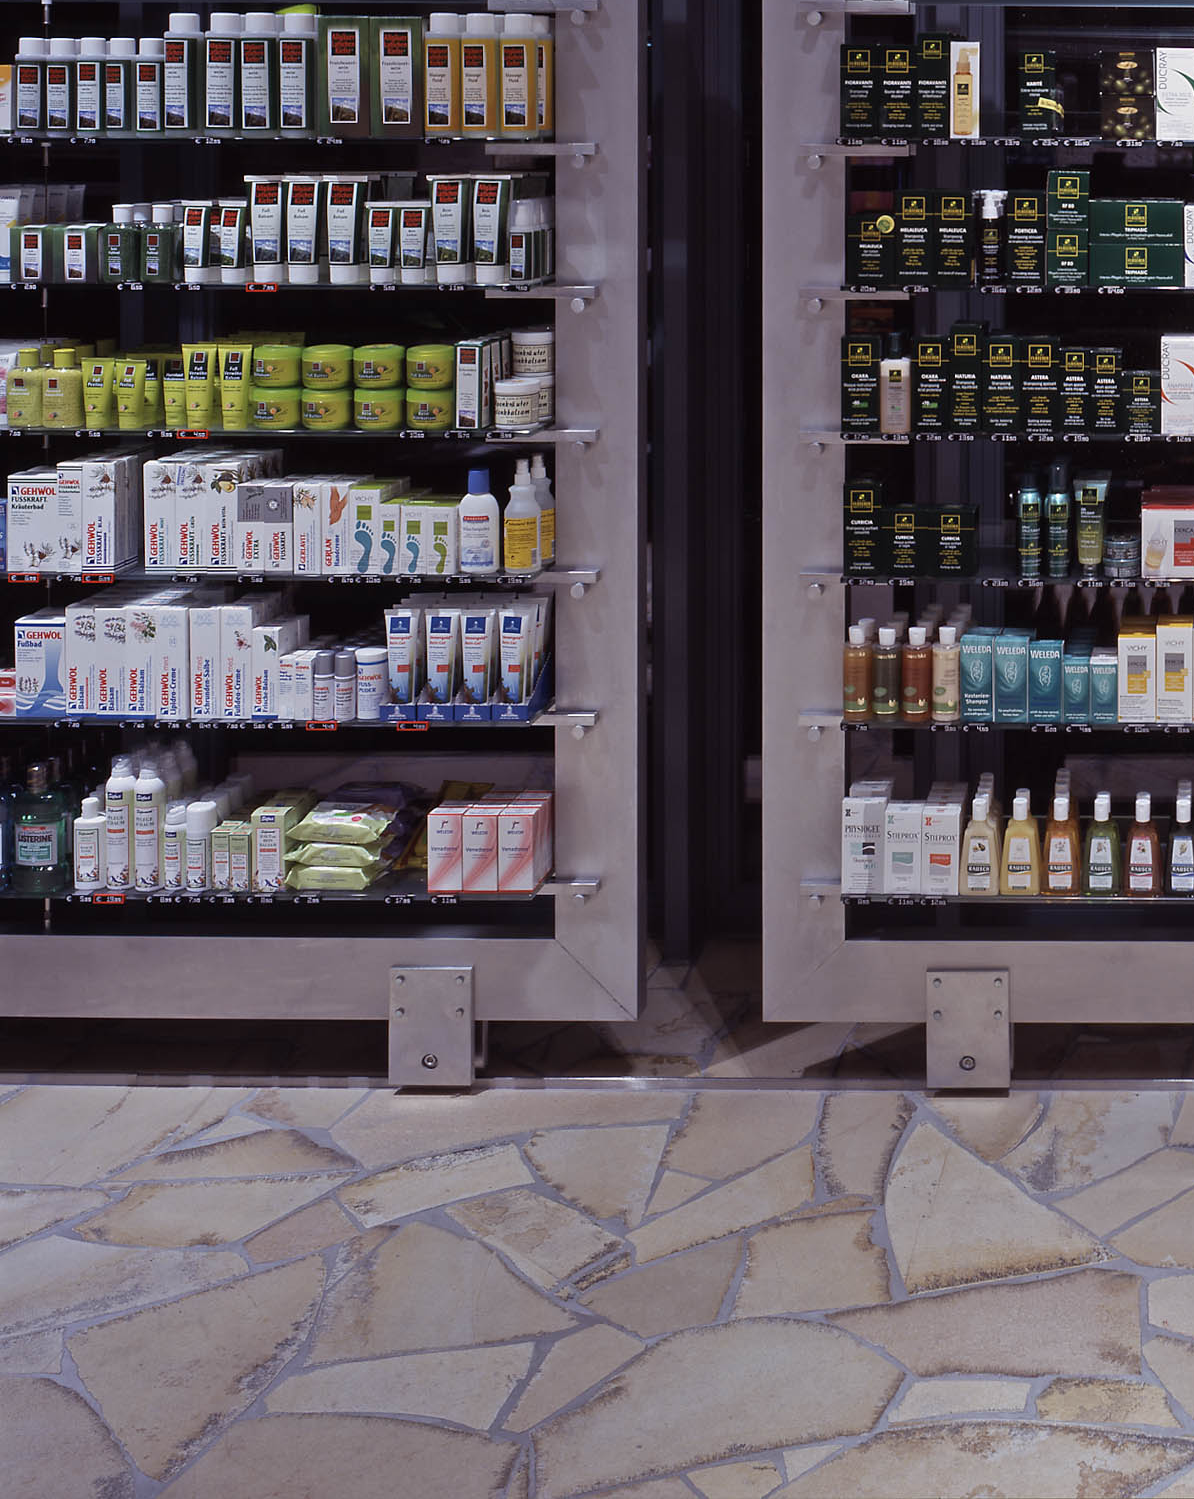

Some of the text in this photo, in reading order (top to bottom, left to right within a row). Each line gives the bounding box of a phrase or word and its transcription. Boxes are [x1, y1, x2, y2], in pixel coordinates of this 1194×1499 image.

[1158, 51, 1168, 90] DUCRAY
[1162, 341, 1170, 380] DUCRAY
[20, 486, 56, 496] GEHWOL
[87, 521, 96, 555] GEHWOL
[150, 524, 158, 556] GEHWOL
[180, 522, 188, 556] GEHWOL
[211, 523, 220, 556] GEHWOL
[245, 530, 253, 559] GEHWOL
[324, 538, 332, 567] GERLAN
[17, 640, 42, 648] Fußbad
[26, 631, 62, 639] GEHWOL
[962, 645, 991, 654] WELEDA
[996, 646, 1026, 655] WELEDA
[1030, 650, 1060, 659] WELEDA
[69, 666, 77, 700] GEHWOL
[129, 667, 138, 702] GEHWOL
[1064, 665, 1088, 674] WELEDA
[1092, 666, 1116, 674] WELEDA
[99, 668, 107, 702] GEHWOL
[161, 672, 169, 706] GEHWOL
[194, 672, 203, 706] GEHWOL
[224, 674, 233, 708] GEHWOL
[18, 834, 53, 843] LISTERINE
[844, 825, 881, 833] PHYSIOGEL
